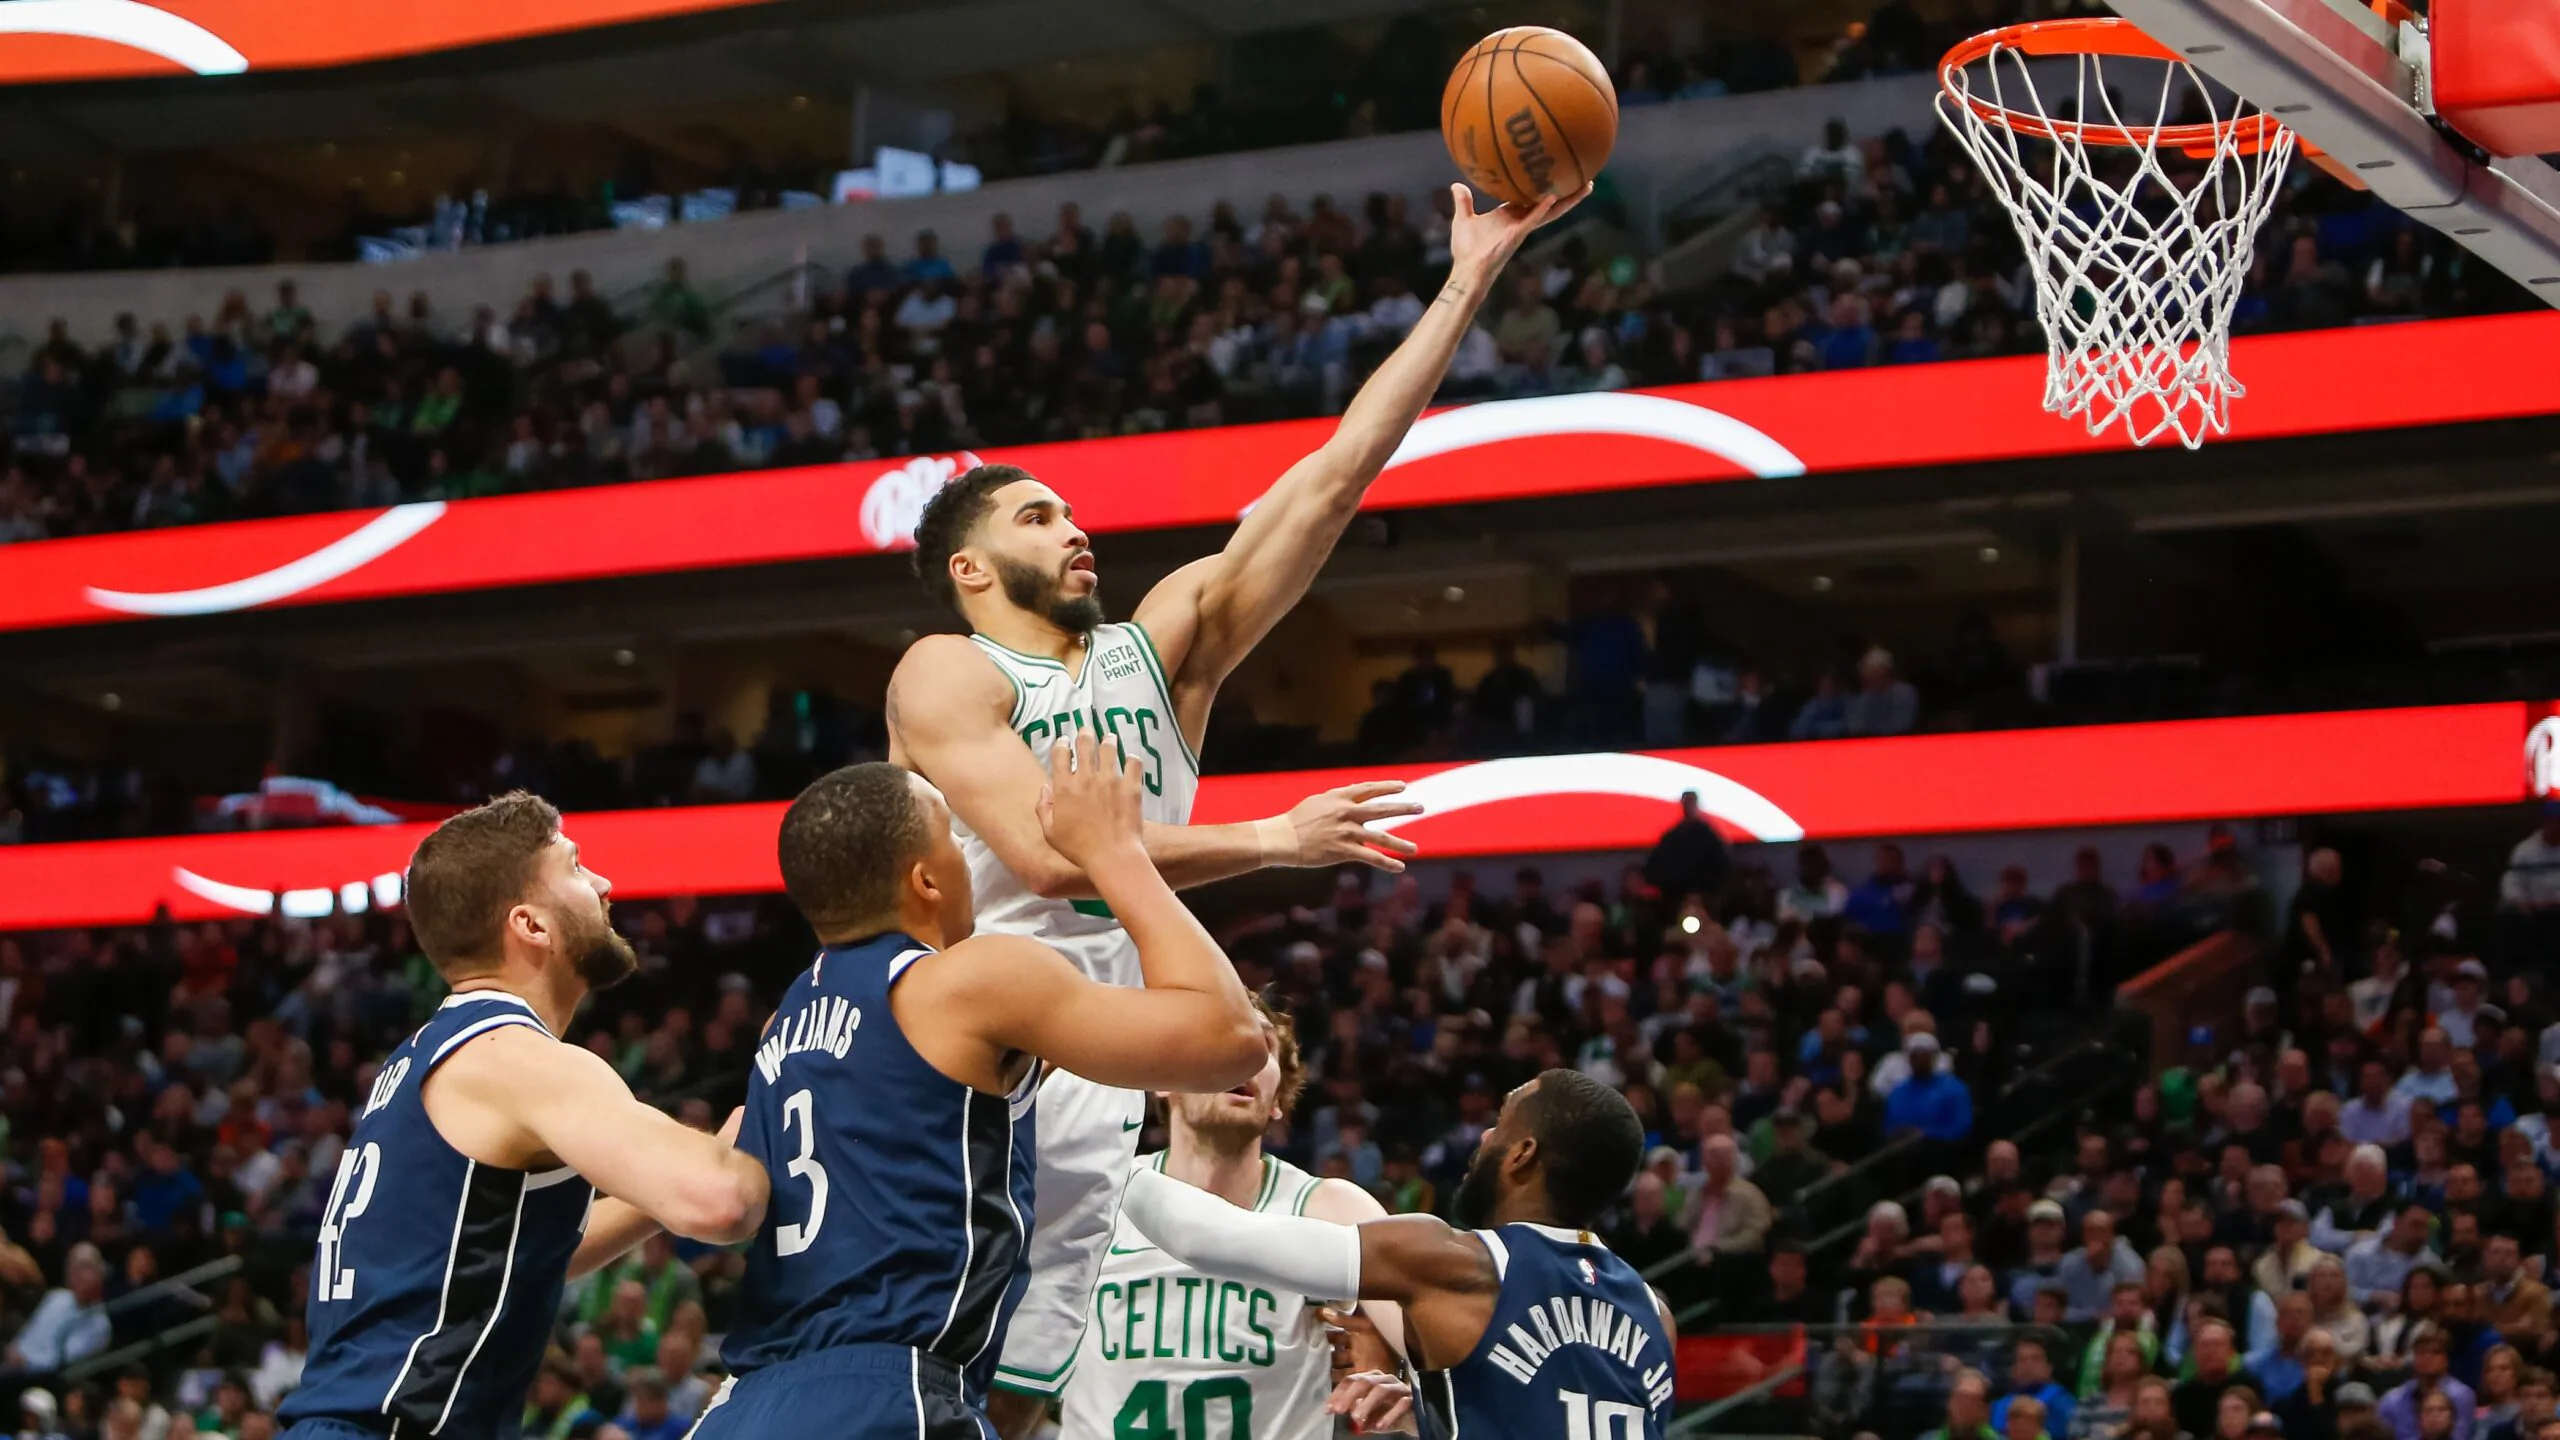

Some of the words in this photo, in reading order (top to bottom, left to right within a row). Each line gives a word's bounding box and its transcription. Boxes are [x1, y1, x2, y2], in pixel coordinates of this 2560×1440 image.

[1096, 644, 1138, 669] VISTA
[1103, 659, 1142, 681] PRINT
[755, 996, 862, 1086] WILLIAMS
[776, 1088, 829, 1257] 3
[317, 1141, 381, 1302] 42
[1097, 1276, 1277, 1368] CELTICS
[1487, 1296, 1650, 1385] HARDAWAY
